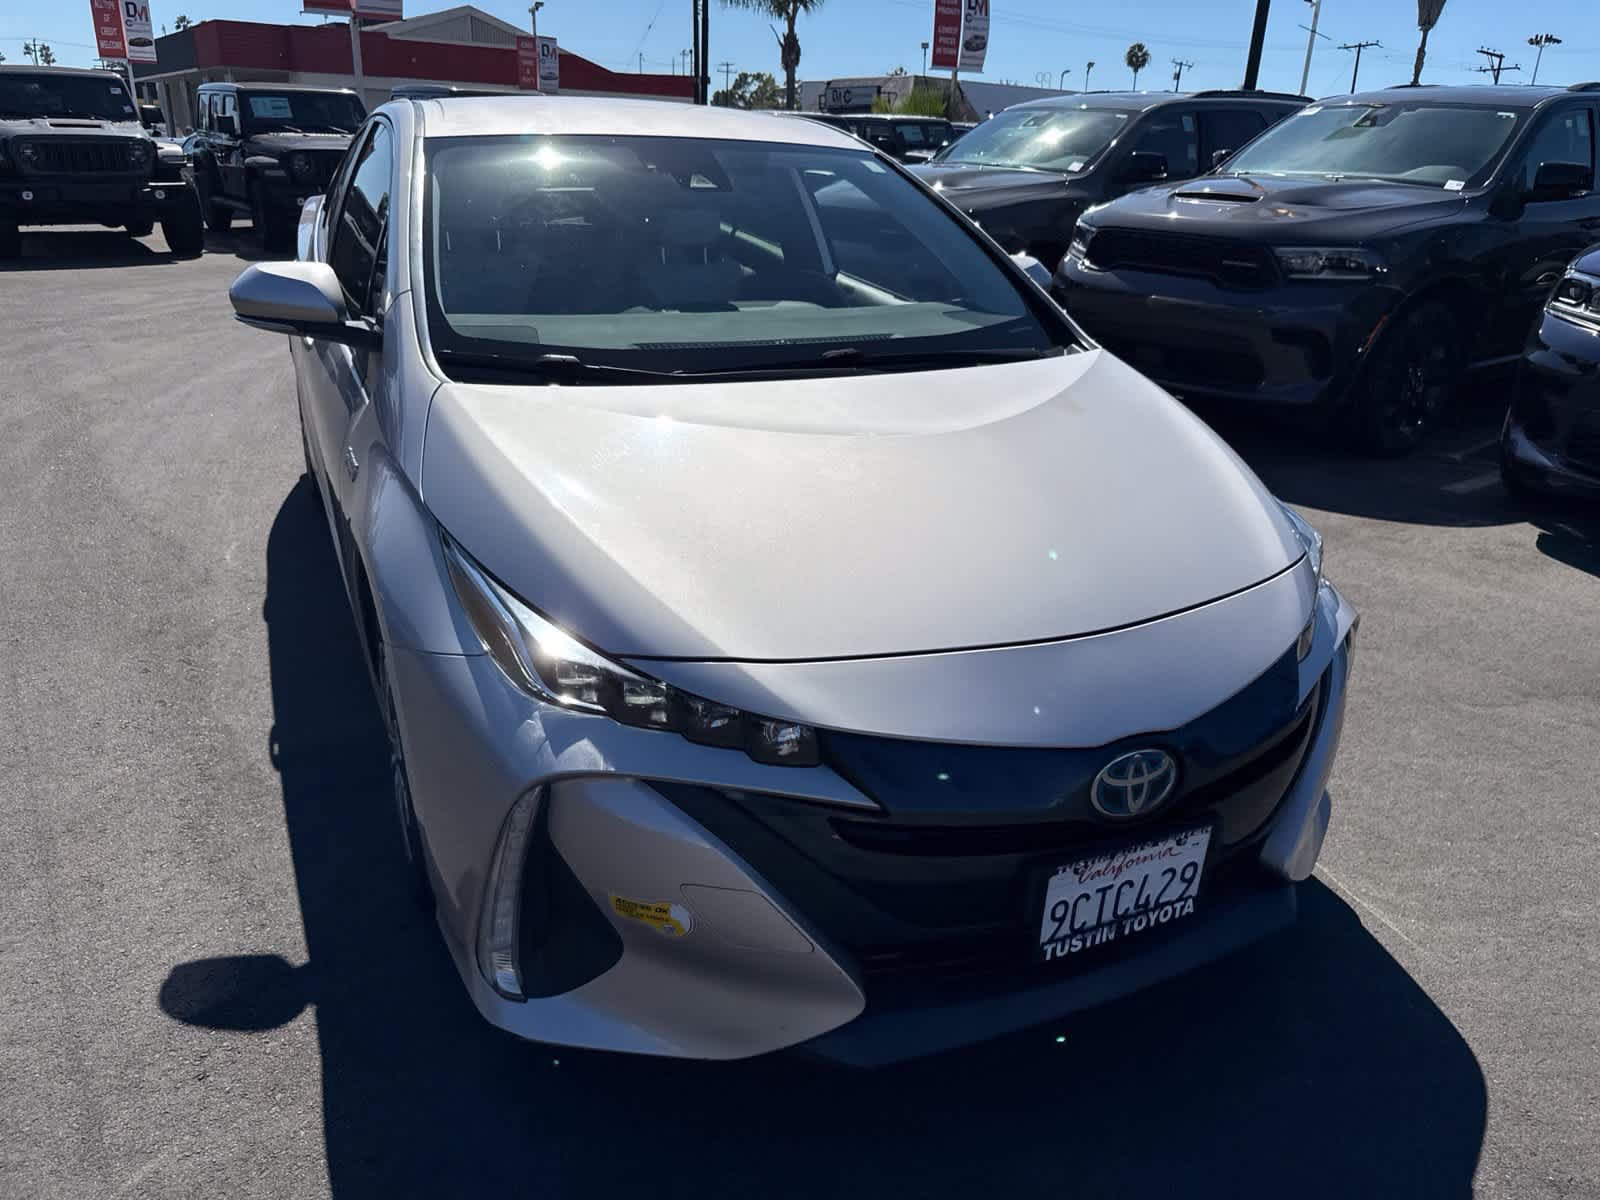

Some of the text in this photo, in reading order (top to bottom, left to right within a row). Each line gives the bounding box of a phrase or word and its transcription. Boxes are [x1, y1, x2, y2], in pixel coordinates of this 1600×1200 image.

[1078, 846, 1183, 884] California
[1043, 897, 1196, 961] TUSTIN TOYOTA
[1047, 860, 1199, 940] 9CTC429
